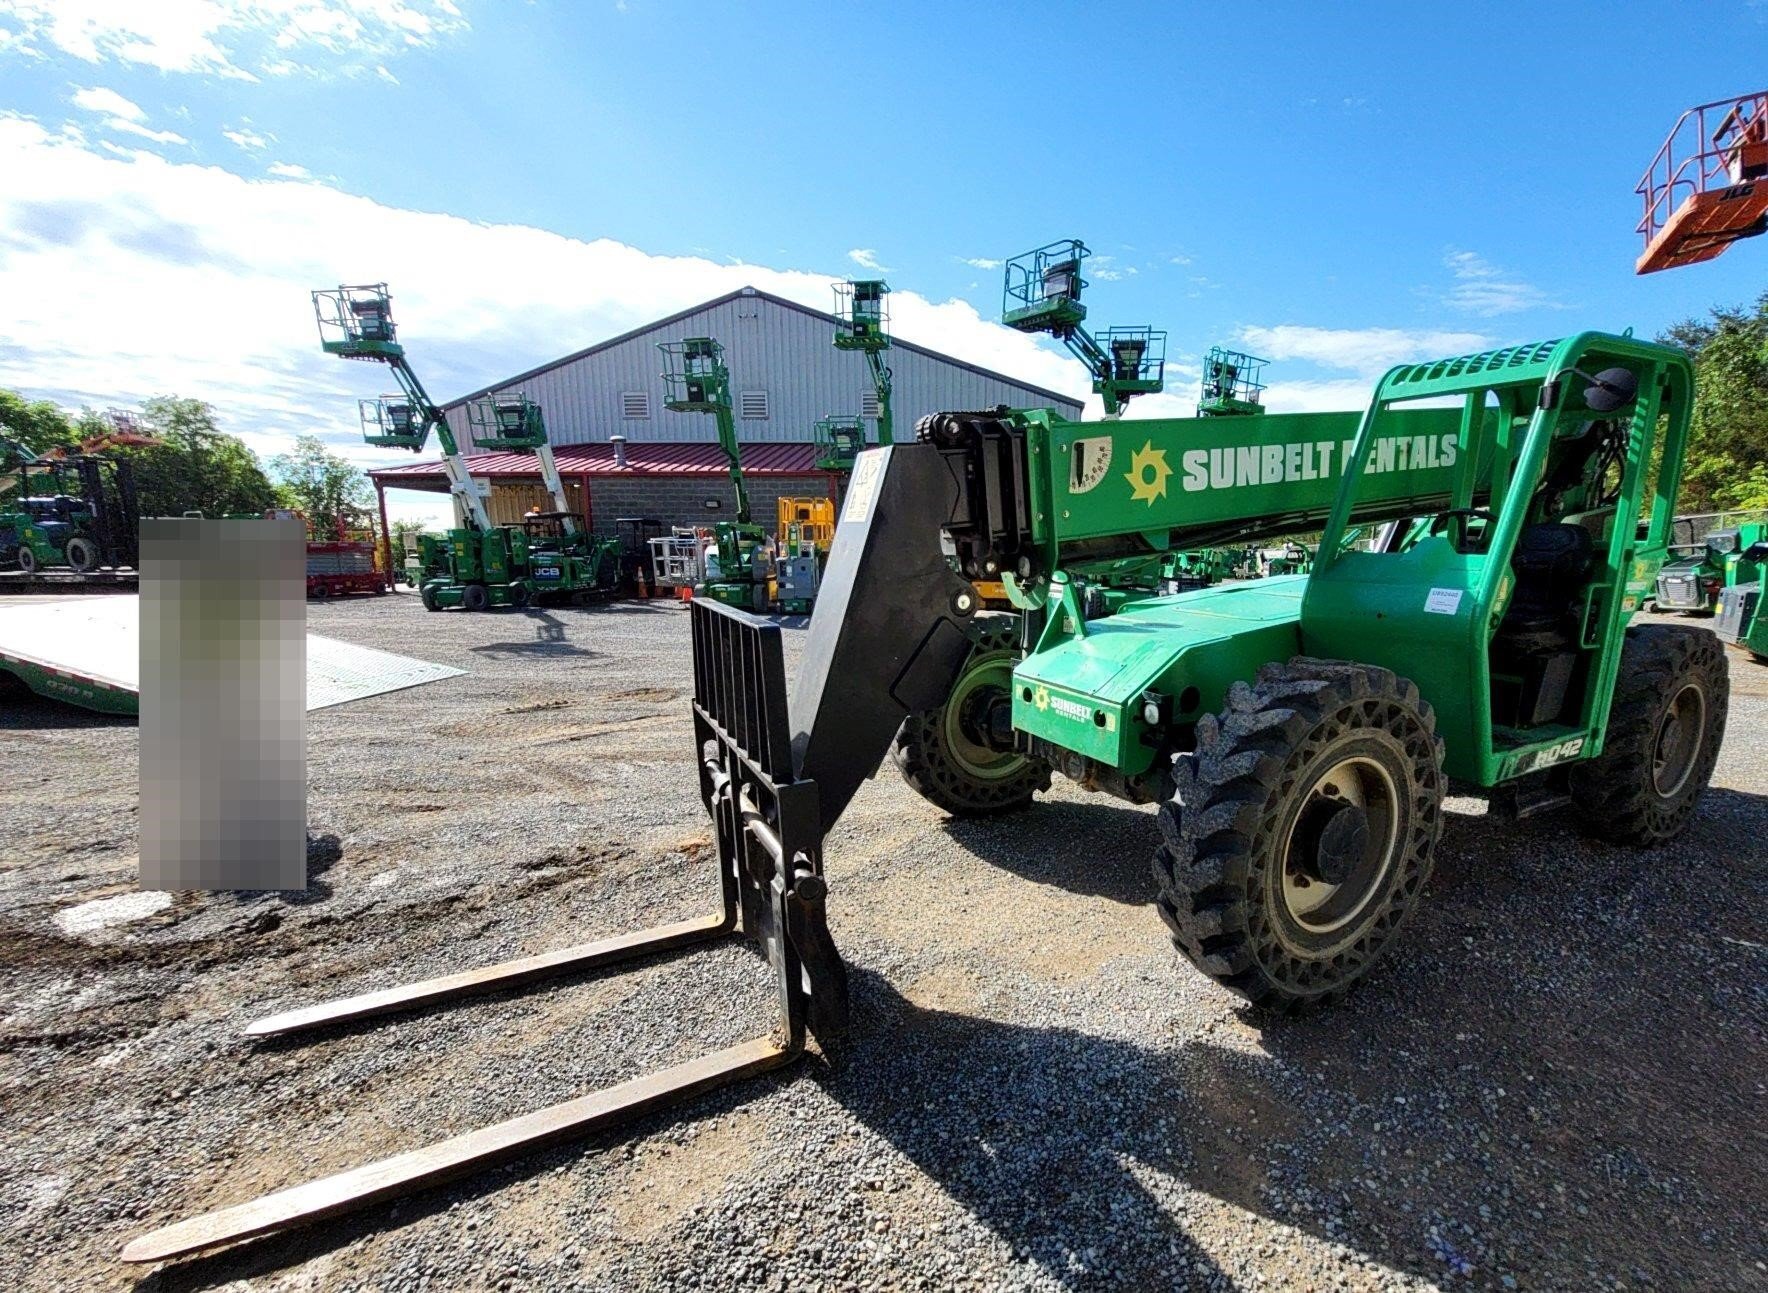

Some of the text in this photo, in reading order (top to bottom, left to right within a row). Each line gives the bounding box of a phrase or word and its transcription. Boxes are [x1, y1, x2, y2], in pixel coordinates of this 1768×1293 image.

[1719, 184, 1754, 201] JLG
[1183, 441, 1335, 492] SUNBELT
[534, 567, 560, 577] JCB
[1051, 696, 1092, 720] SUNBELT
[1055, 709, 1085, 723] RENTALS
